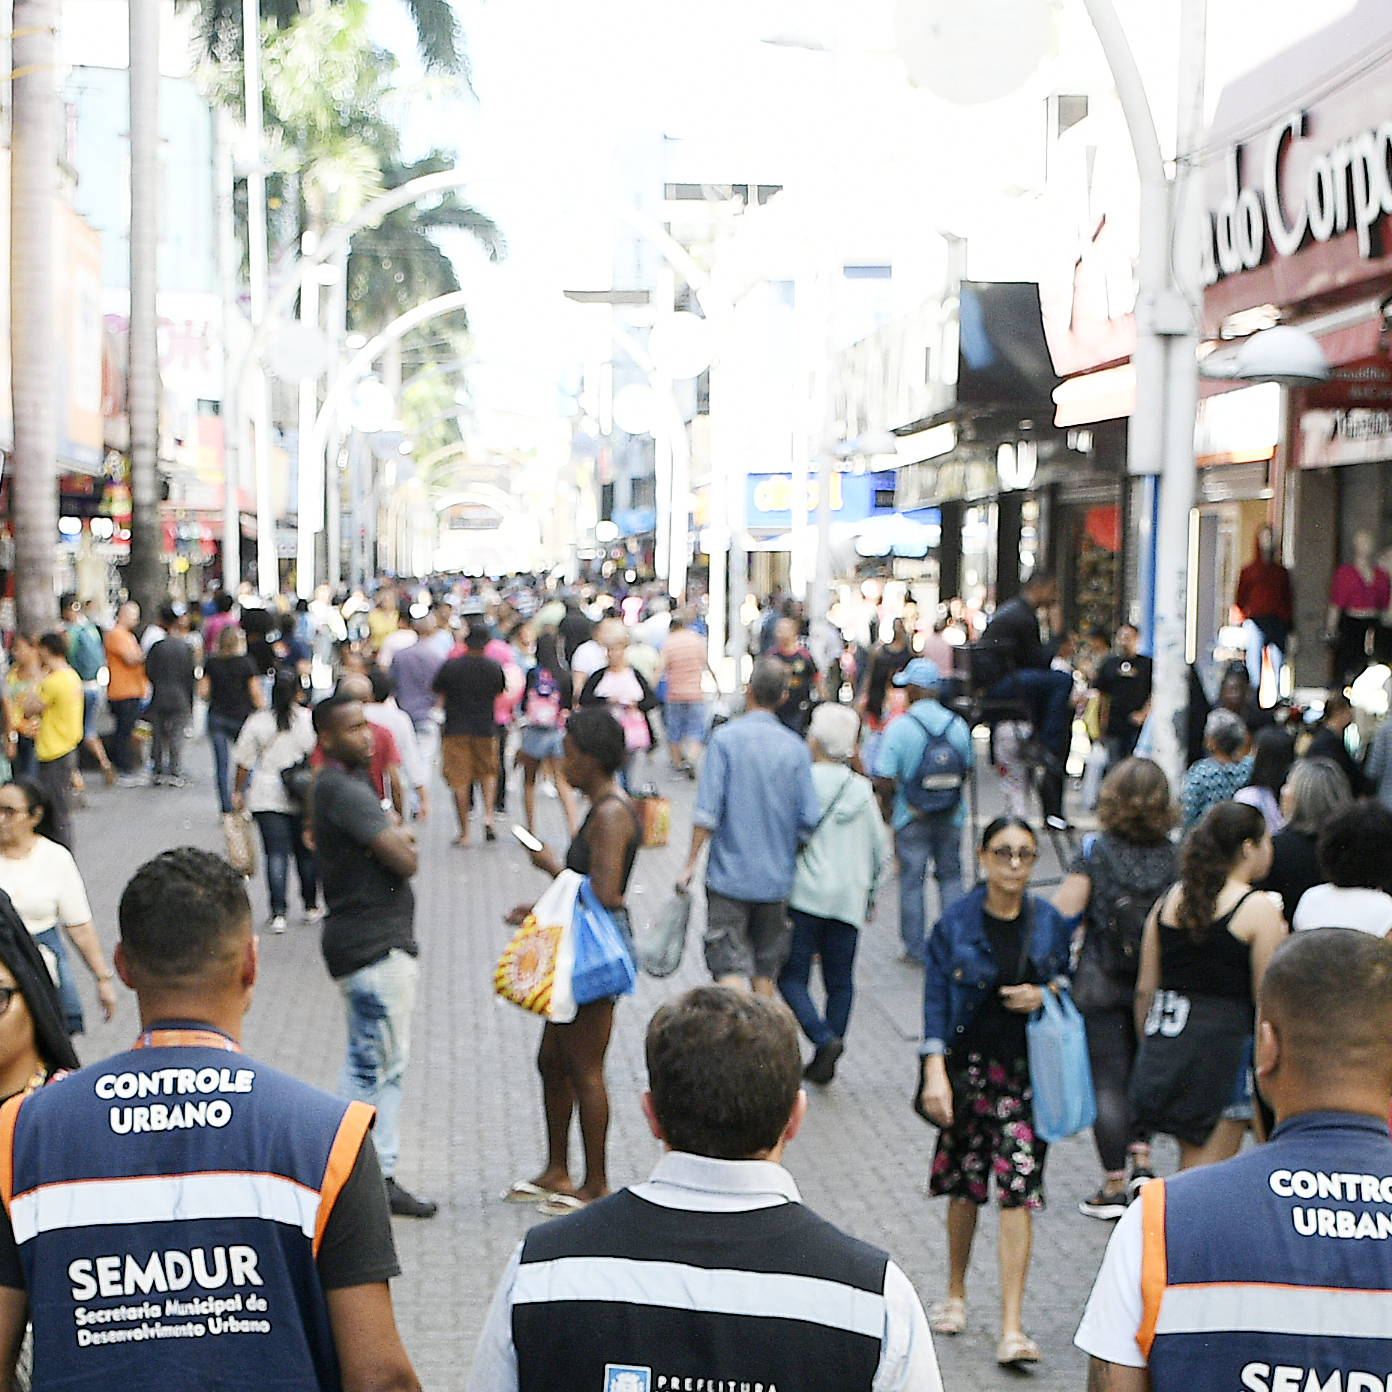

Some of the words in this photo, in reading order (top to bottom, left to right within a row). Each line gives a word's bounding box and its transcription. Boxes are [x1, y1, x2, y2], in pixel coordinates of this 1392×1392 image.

[95, 1069, 255, 1100] CONTROLE
[110, 1100, 232, 1135] URBANO
[68, 1246, 264, 1301] SEMDUR
[74, 1301, 163, 1326] Secretaria
[165, 1294, 243, 1319] Municipal
[245, 1292, 268, 1312] de
[77, 1321, 206, 1348] Desenvolvimento
[208, 1315, 271, 1336] Urbano
